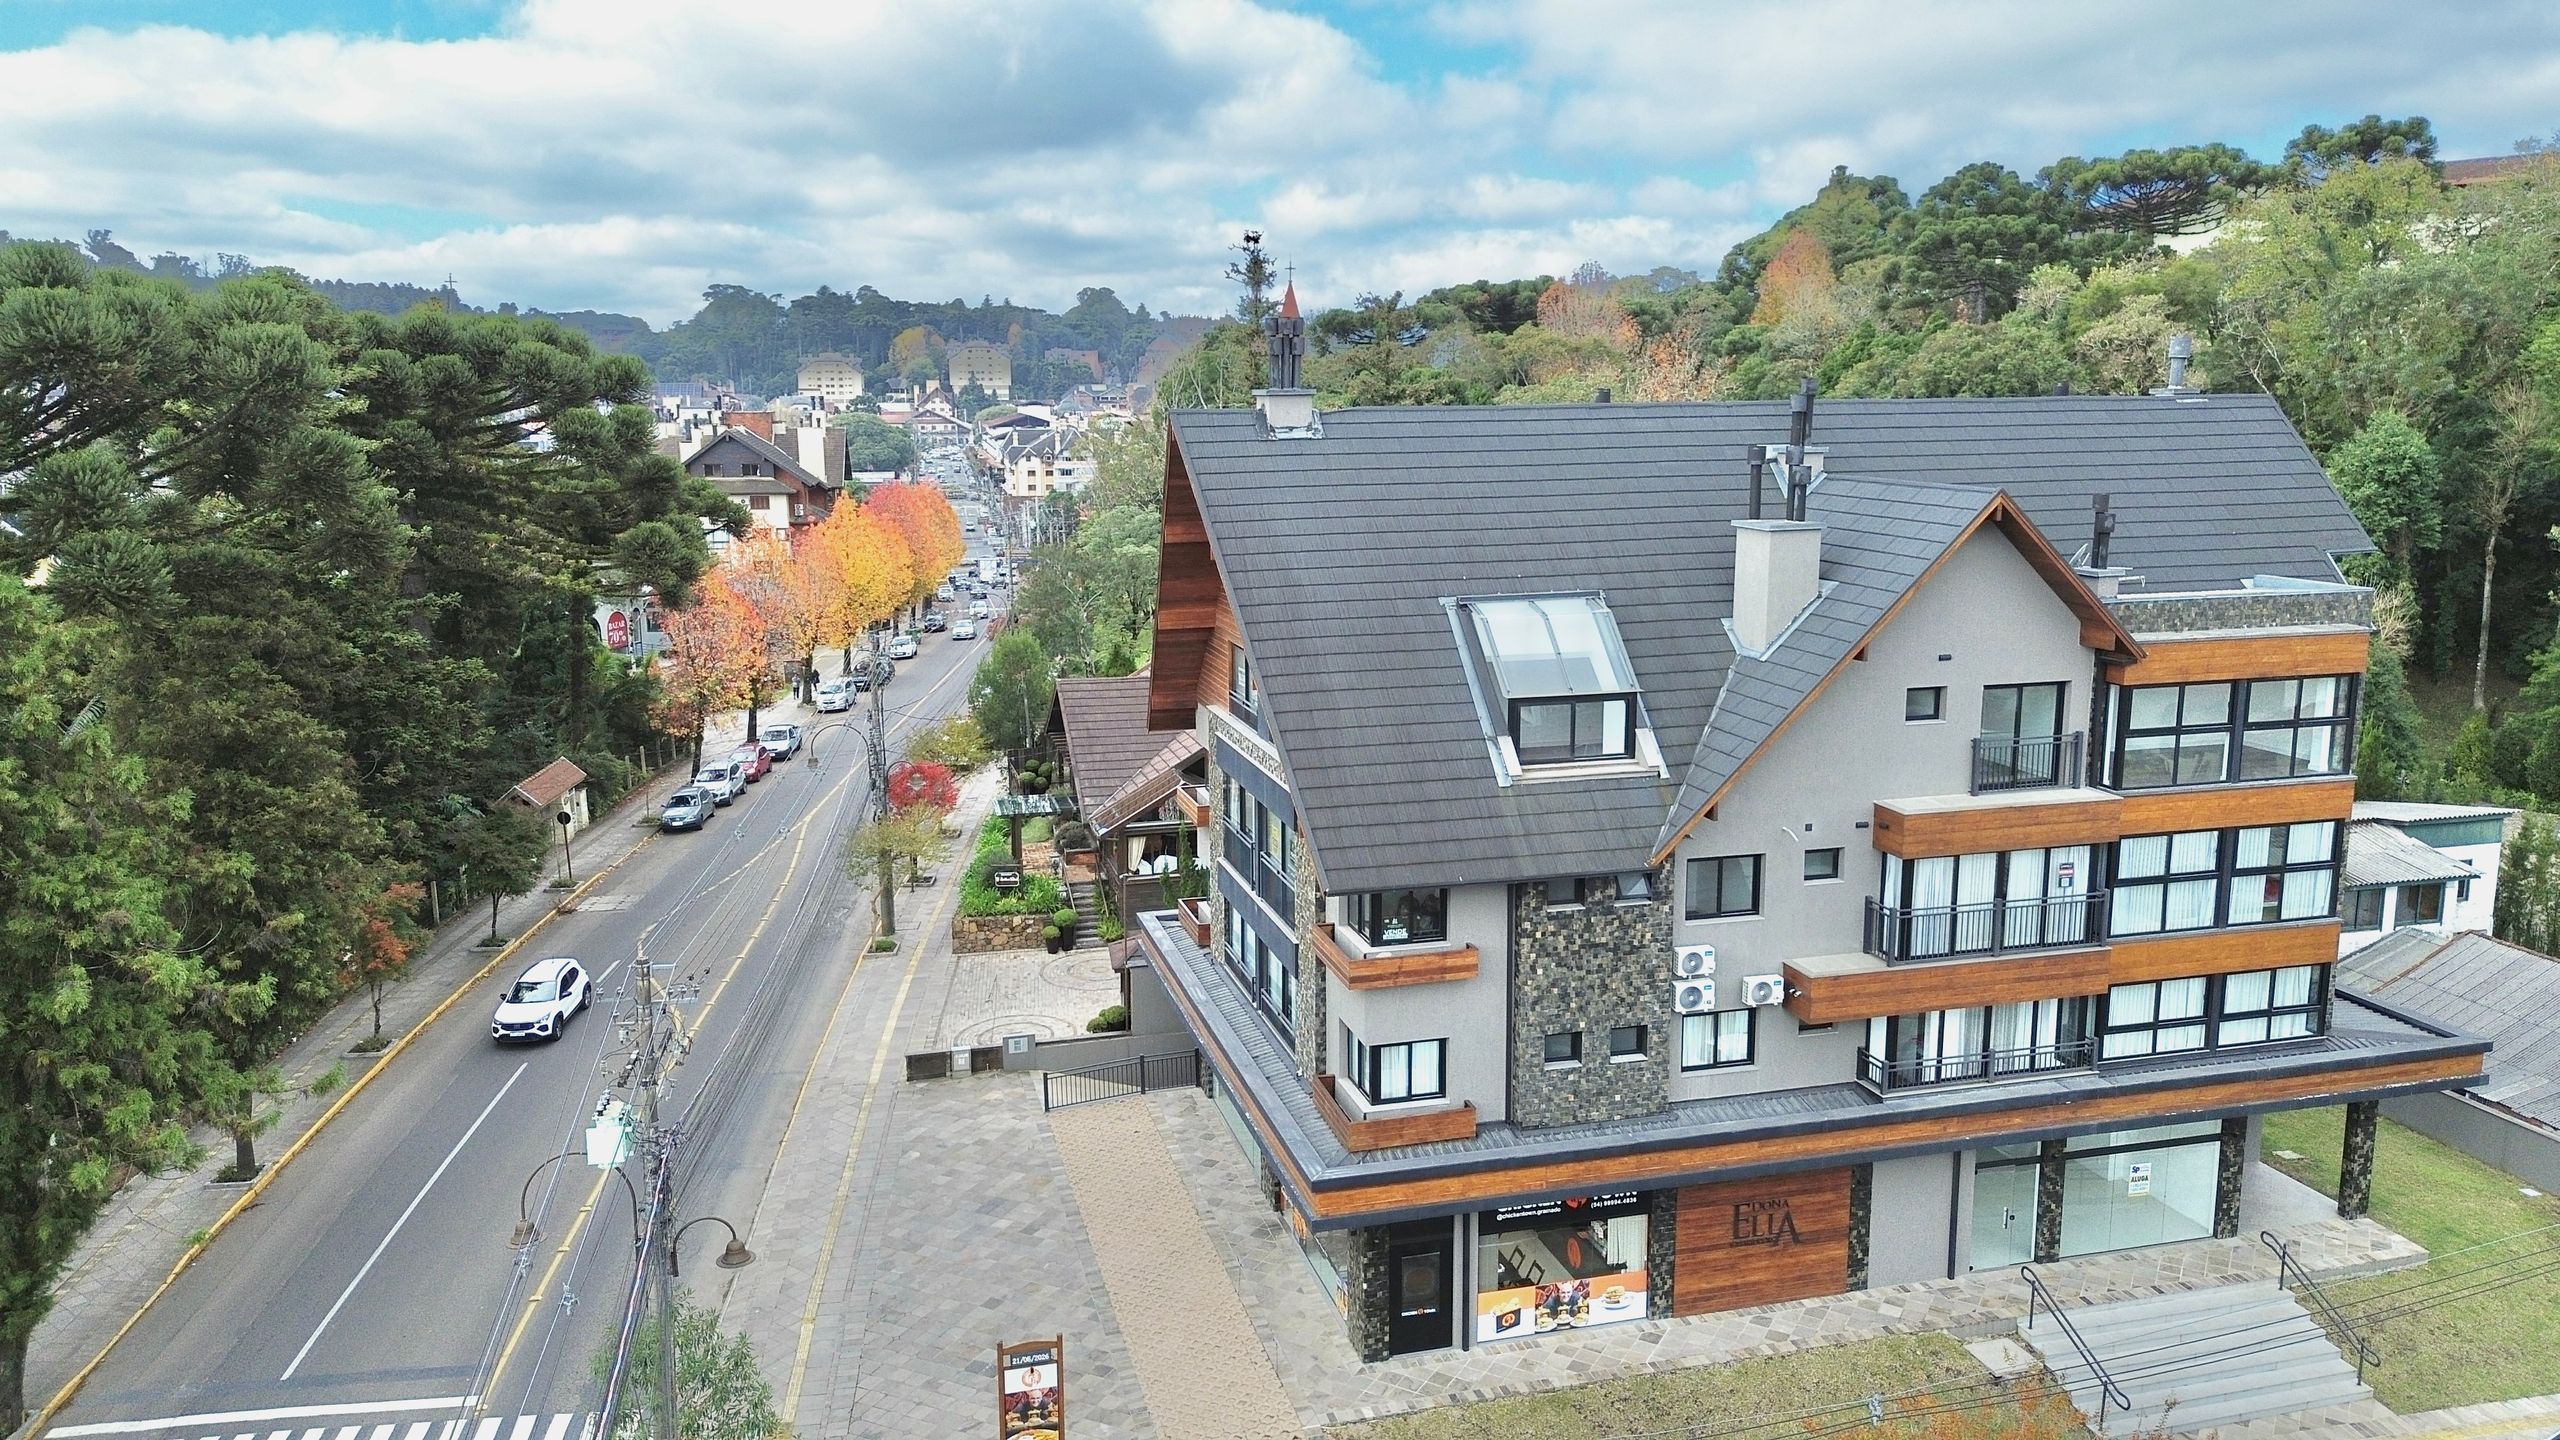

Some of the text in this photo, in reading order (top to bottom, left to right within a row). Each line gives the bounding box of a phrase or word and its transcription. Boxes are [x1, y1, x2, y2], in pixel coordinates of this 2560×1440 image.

[608, 620, 626, 630] BAZAR
[1383, 928, 1407, 937] VENDE
[1751, 1199, 1789, 1212] DONA
